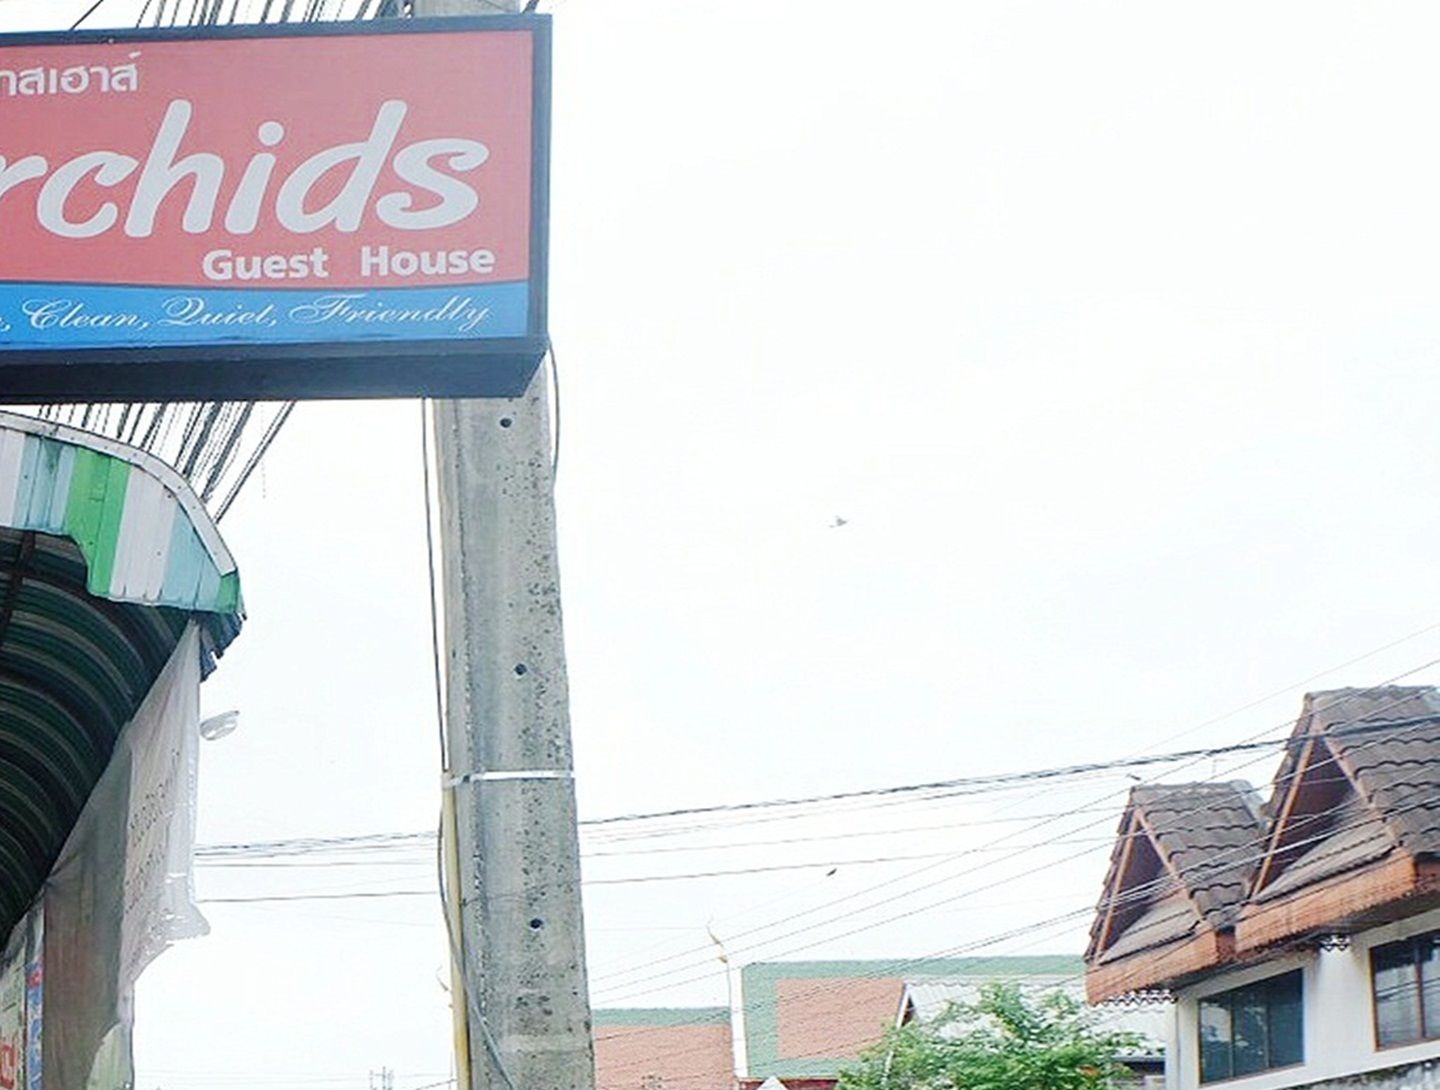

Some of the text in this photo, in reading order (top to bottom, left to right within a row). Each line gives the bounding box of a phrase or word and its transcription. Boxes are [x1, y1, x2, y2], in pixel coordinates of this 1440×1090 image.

[202, 245, 495, 280] Guest House
[22, 299, 151, 330] Clean,
[158, 296, 277, 327] Quiet,
[288, 294, 490, 332] Friendly
